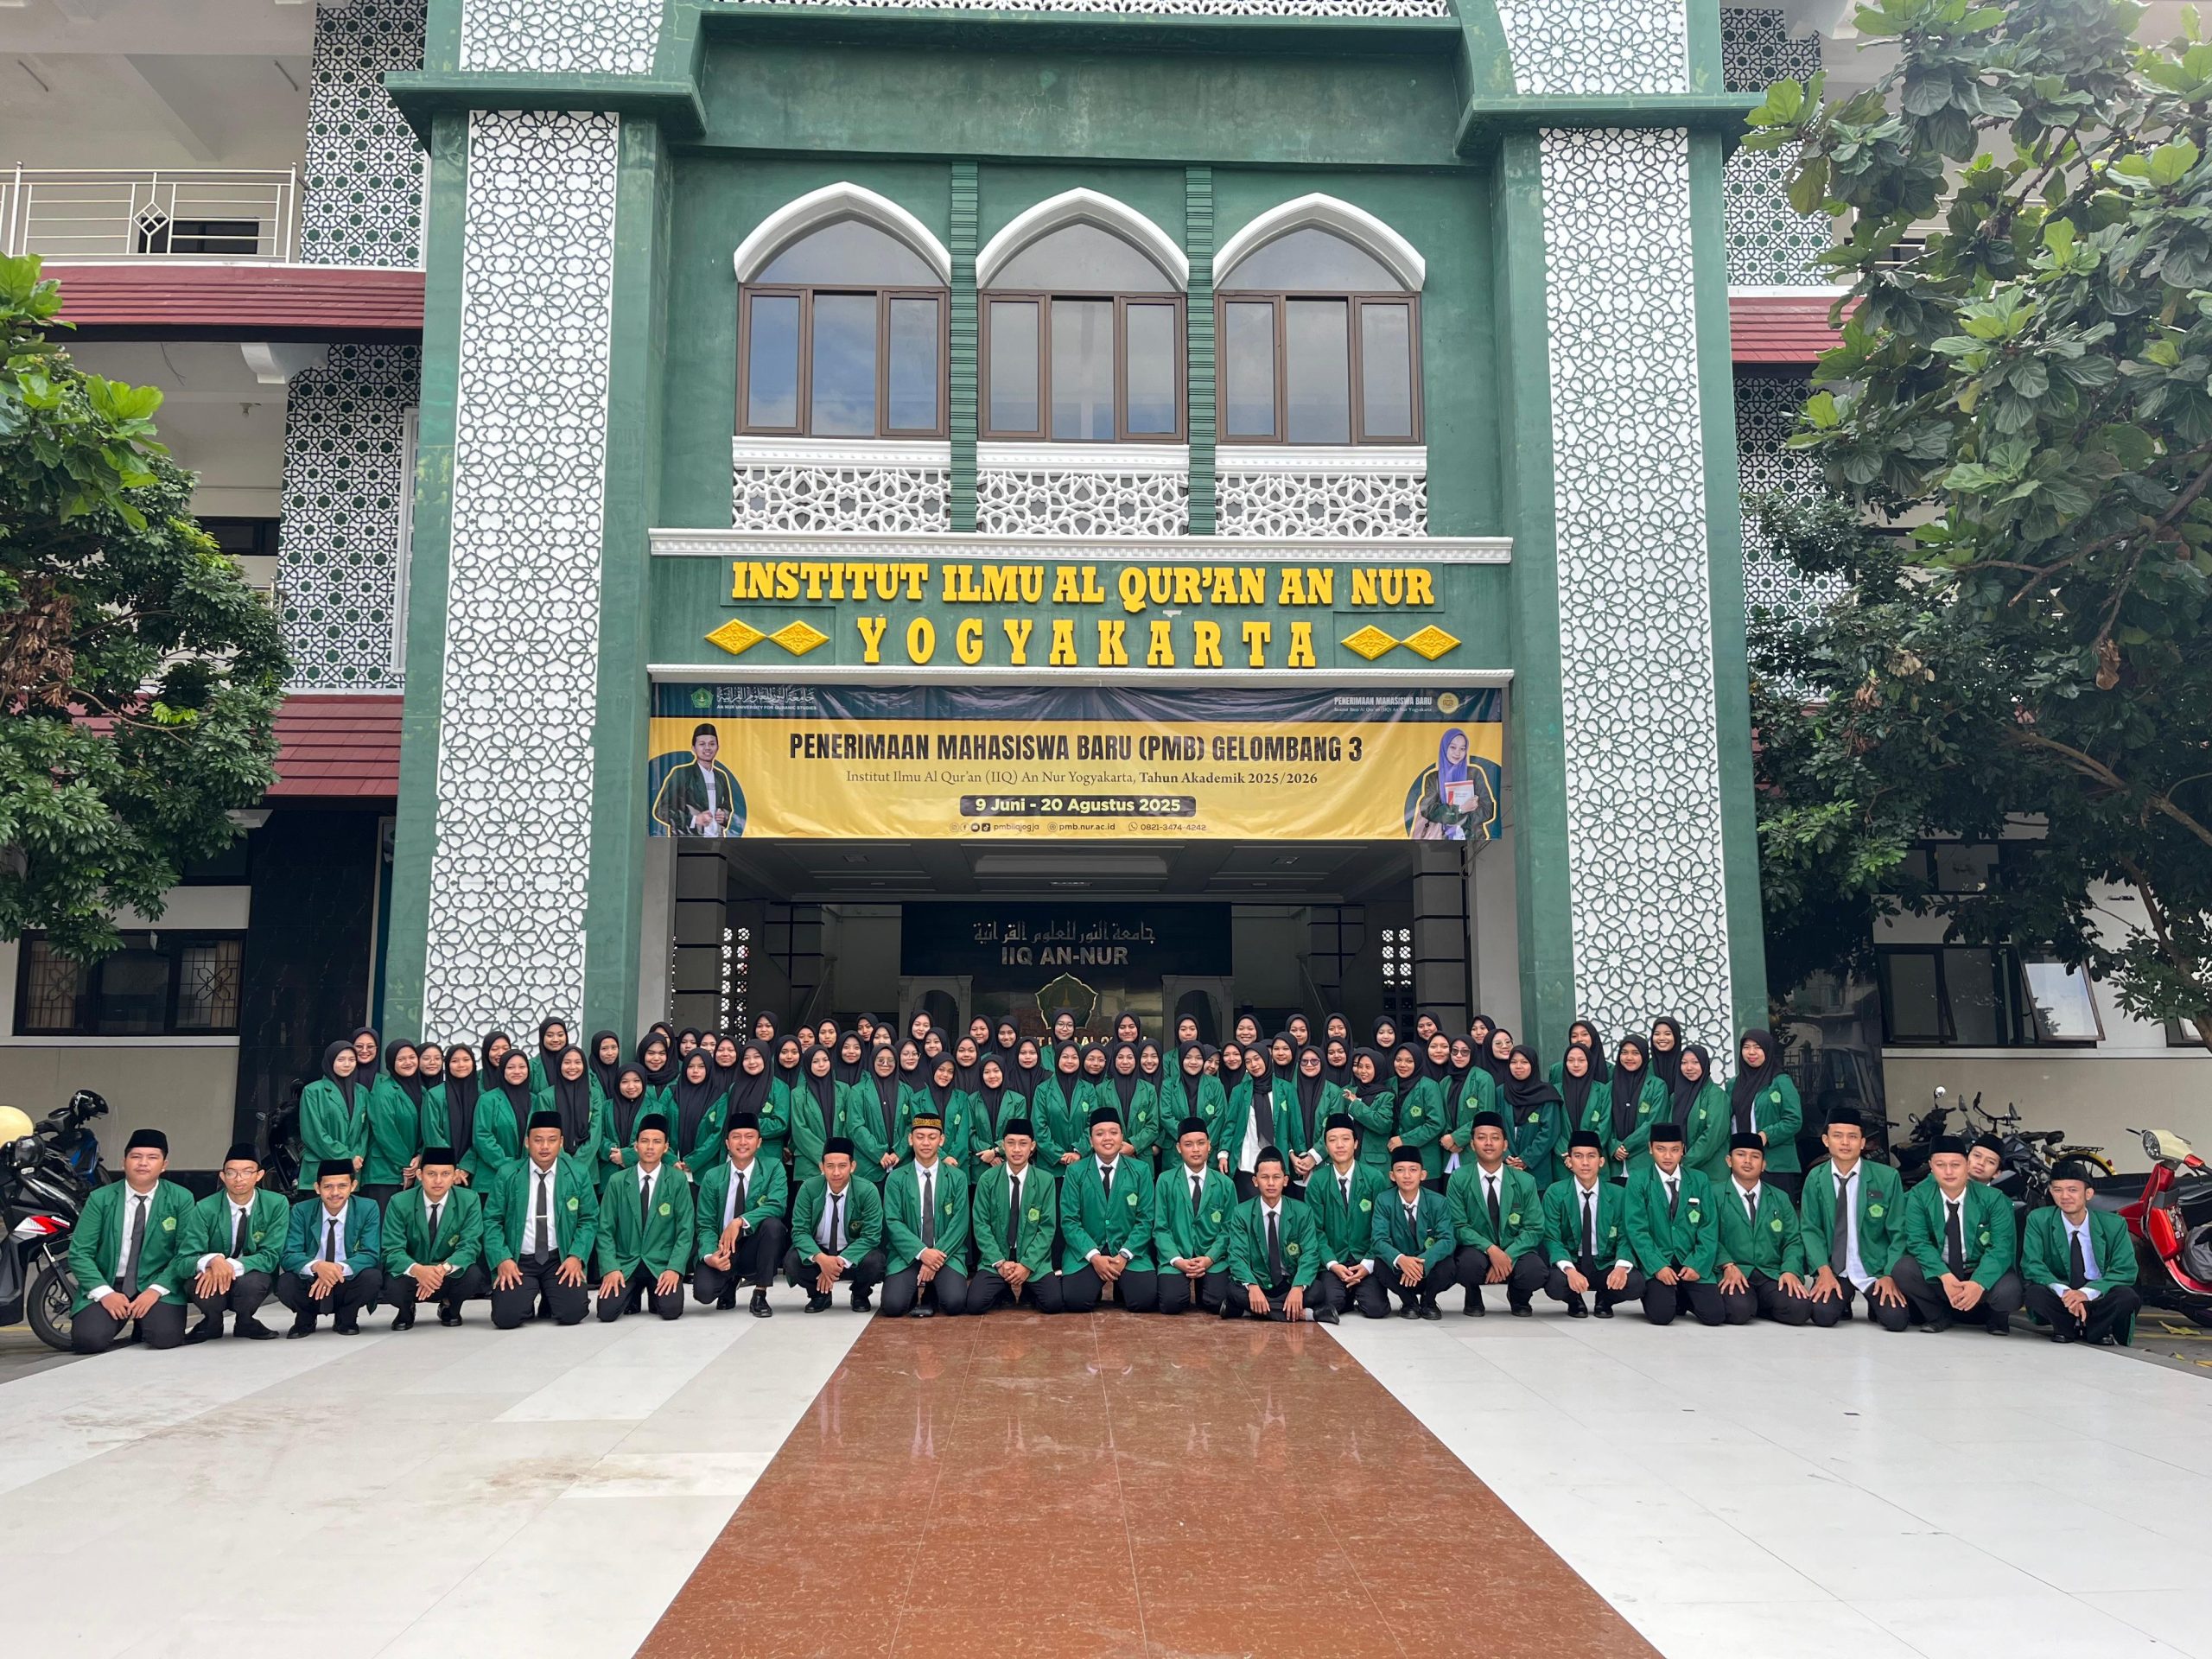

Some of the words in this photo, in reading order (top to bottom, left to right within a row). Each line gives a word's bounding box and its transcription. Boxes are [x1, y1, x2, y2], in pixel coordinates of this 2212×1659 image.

[732, 561, 929, 601] INSTITUT
[943, 563, 1045, 603] ILMU
[1053, 565, 1105, 603] AL
[1119, 566, 1266, 613] QUR'AN
[1279, 568, 1334, 605] AN
[1351, 568, 1435, 605] NUR
[856, 616, 1317, 668] YOGYAKARTA
[1334, 696, 1374, 705] PENERIMAAN
[1376, 696, 1414, 705] MAHASISWA
[1415, 696, 1432, 705] BARU
[790, 733, 929, 760] PENERIMAAN
[938, 734, 1070, 760] MAHASISWA
[1077, 735, 1131, 760] BARU
[1139, 735, 1205, 761] (PMB)
[1212, 736, 1341, 762] GELOMBANG
[1349, 736, 1363, 762] 3
[846, 771, 890, 782] Institut
[893, 771, 921, 782] Ilmu
[925, 771, 938, 782] Al
[985, 771, 1018, 785] (IIQ)
[1022, 772, 1039, 782] An
[1042, 772, 1065, 782] Nur
[1068, 771, 1136, 785] Yogyakarta,
[1138, 772, 1179, 783] Tahun
[1181, 772, 1245, 784] Akademik
[1248, 772, 1318, 785] 2025/2026
[975, 798, 987, 811] 9
[991, 798, 1026, 811] Juni
[1040, 798, 1063, 811] 20
[1067, 798, 1135, 814] Agustus
[1139, 798, 1181, 811] 2025
[1058, 822, 1116, 831] pmb.nur.ac.id
[1140, 823, 1207, 831] 0821-3474-4242
[1001, 947, 1033, 966] IIQ
[1039, 947, 1129, 965] AN-NUR
